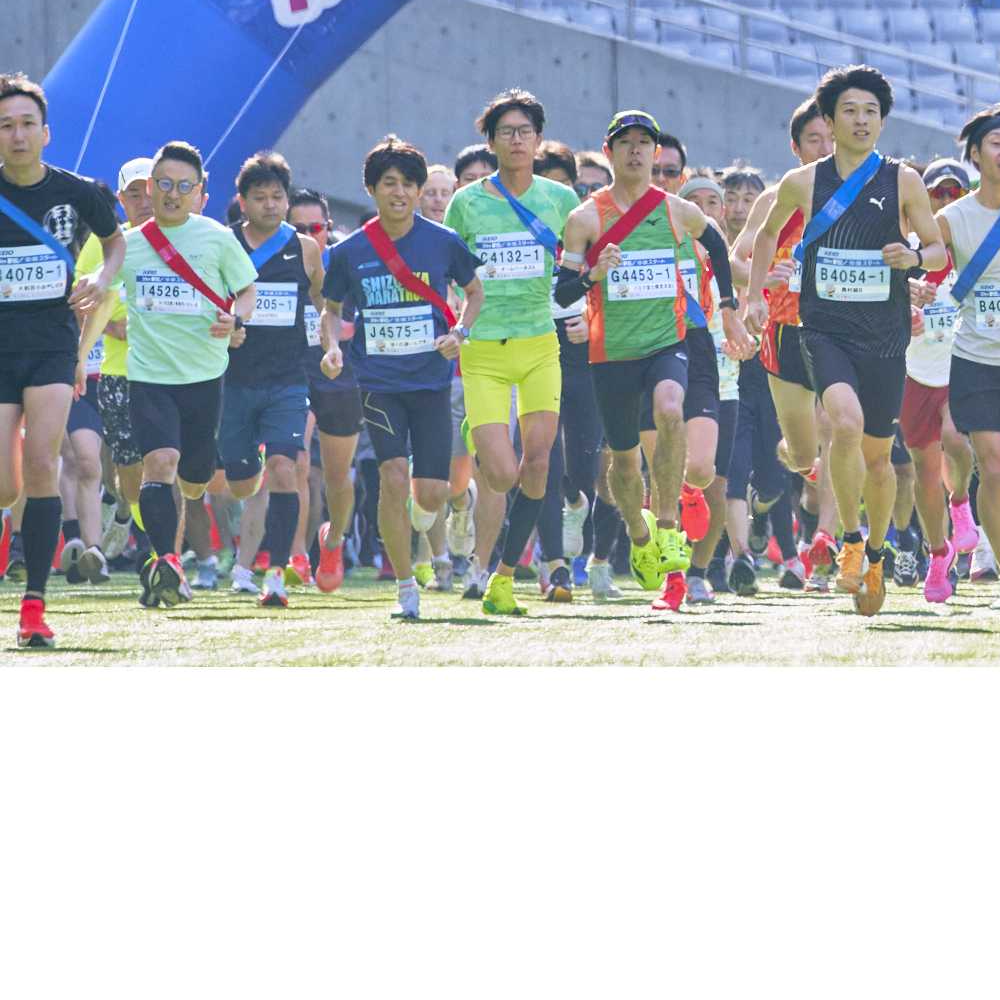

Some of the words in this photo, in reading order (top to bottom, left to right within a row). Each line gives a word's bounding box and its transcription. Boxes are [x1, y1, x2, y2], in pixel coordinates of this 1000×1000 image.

[610, 268, 671, 283] G4453-1
[820, 266, 885, 285] B4054-1
[370, 323, 428, 339] J4575-1
